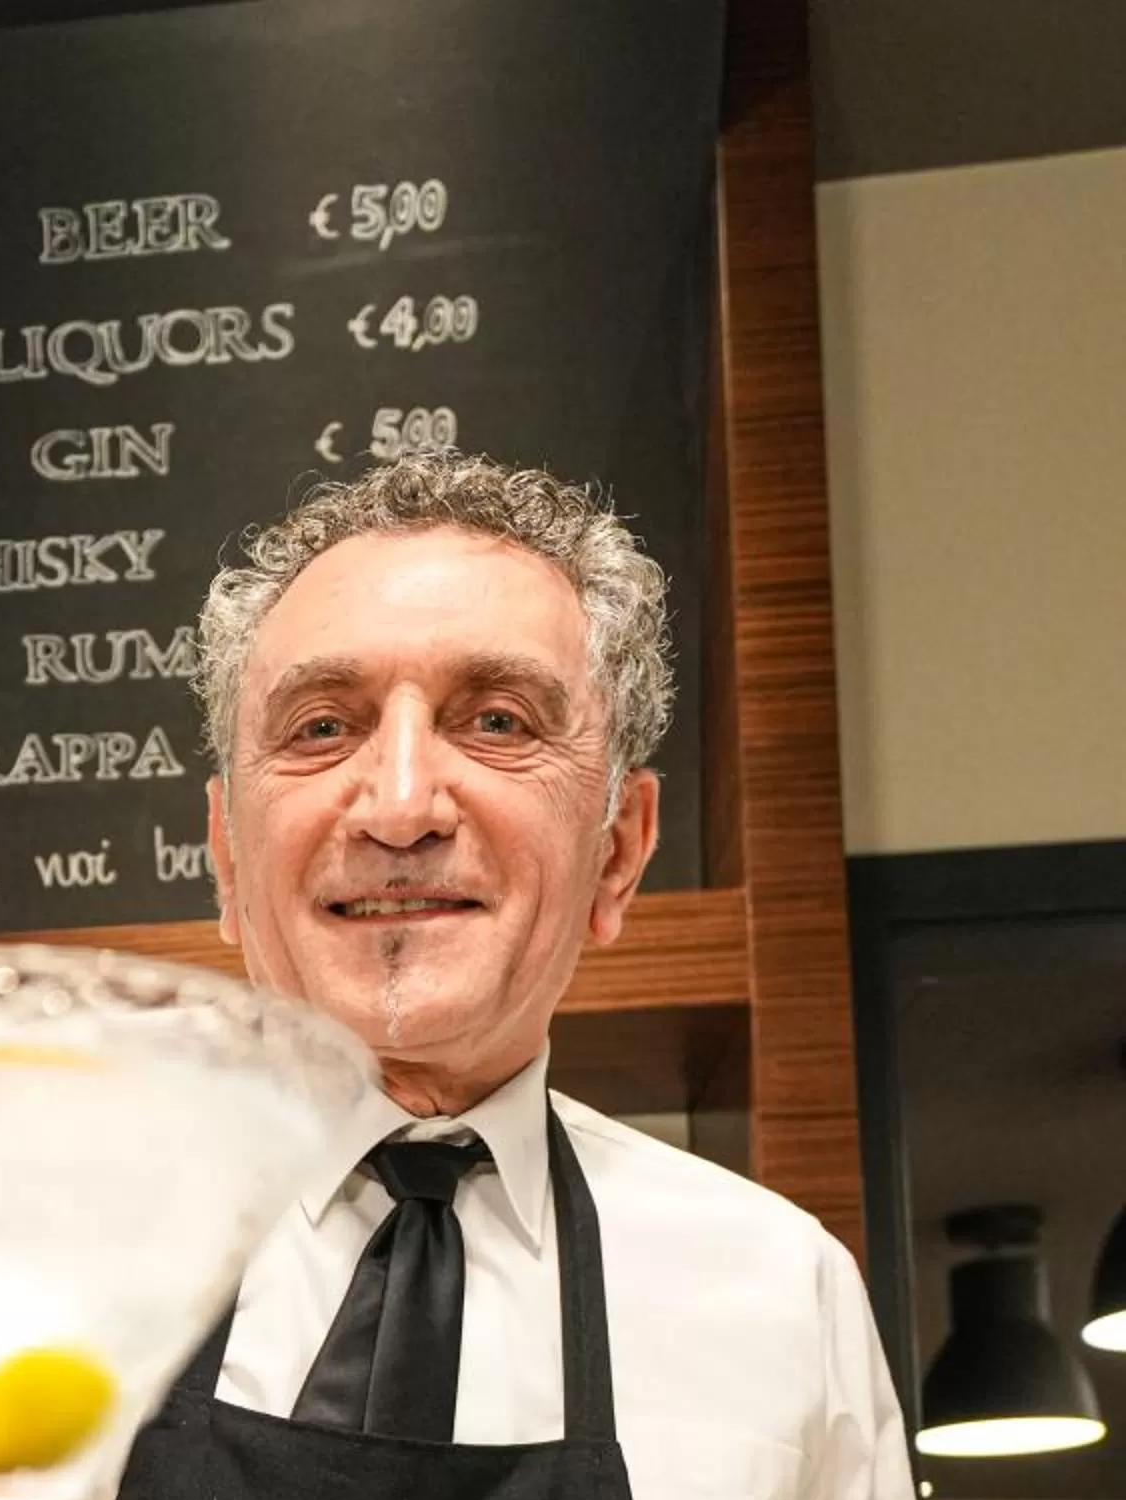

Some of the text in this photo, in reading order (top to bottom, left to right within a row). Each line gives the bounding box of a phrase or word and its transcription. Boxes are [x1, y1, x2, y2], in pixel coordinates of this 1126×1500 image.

[39, 193, 232, 263] BEER
[31, 422, 175, 481] GIN
[22, 626, 200, 685] RUM
